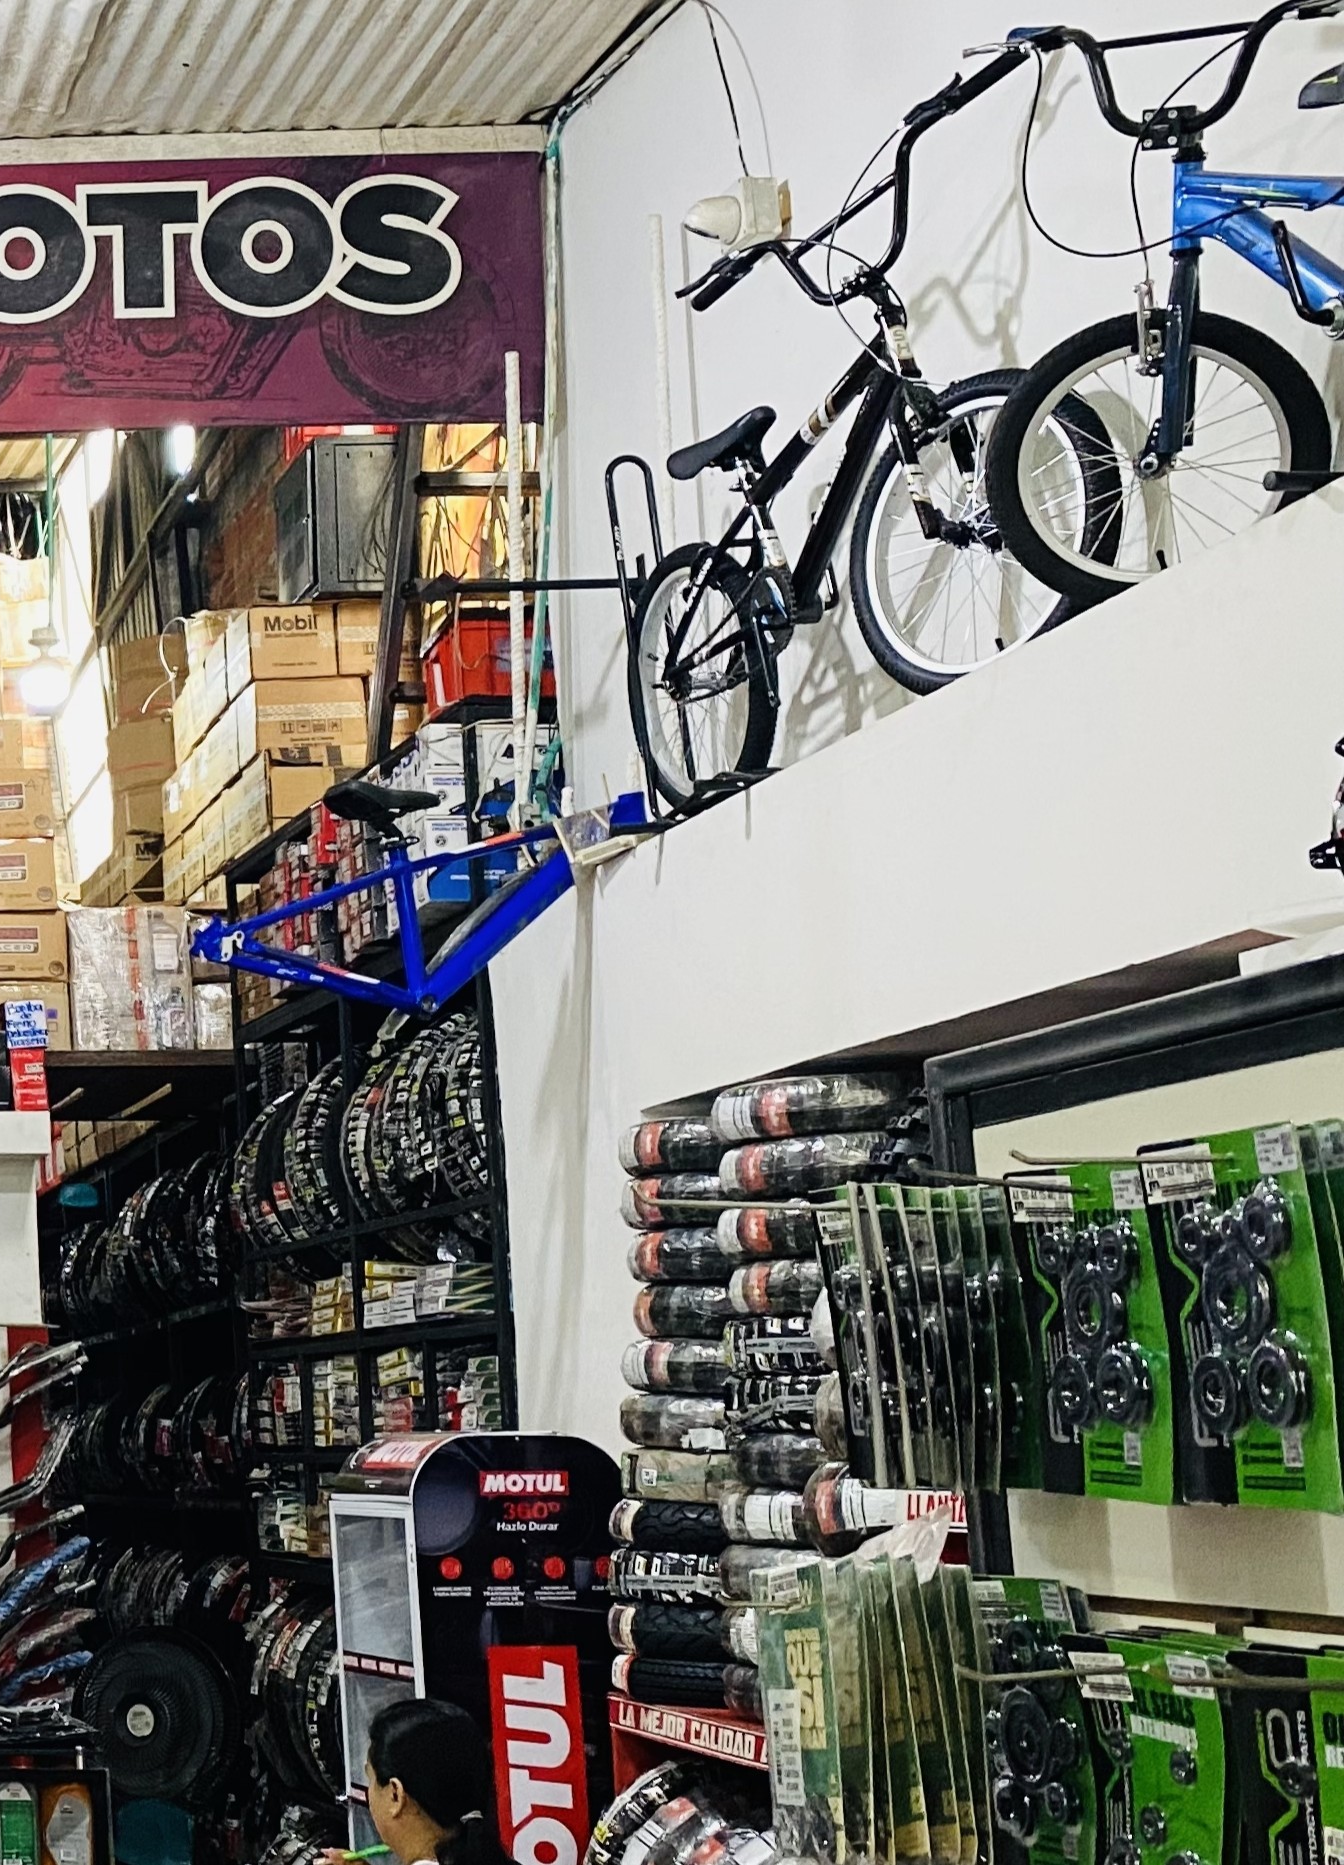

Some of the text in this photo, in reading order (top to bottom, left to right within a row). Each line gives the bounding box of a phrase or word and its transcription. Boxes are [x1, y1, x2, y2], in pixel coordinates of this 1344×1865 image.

[264, 613, 320, 632] Mobil
[483, 1473, 566, 1493] MOTUL
[496, 1521, 559, 1532] Hazlo Durar
[618, 1702, 636, 1728] LA
[639, 1707, 687, 1742] MEJOR
[689, 1719, 756, 1760] CALIDAD
[502, 1660, 578, 1865] OTUL
